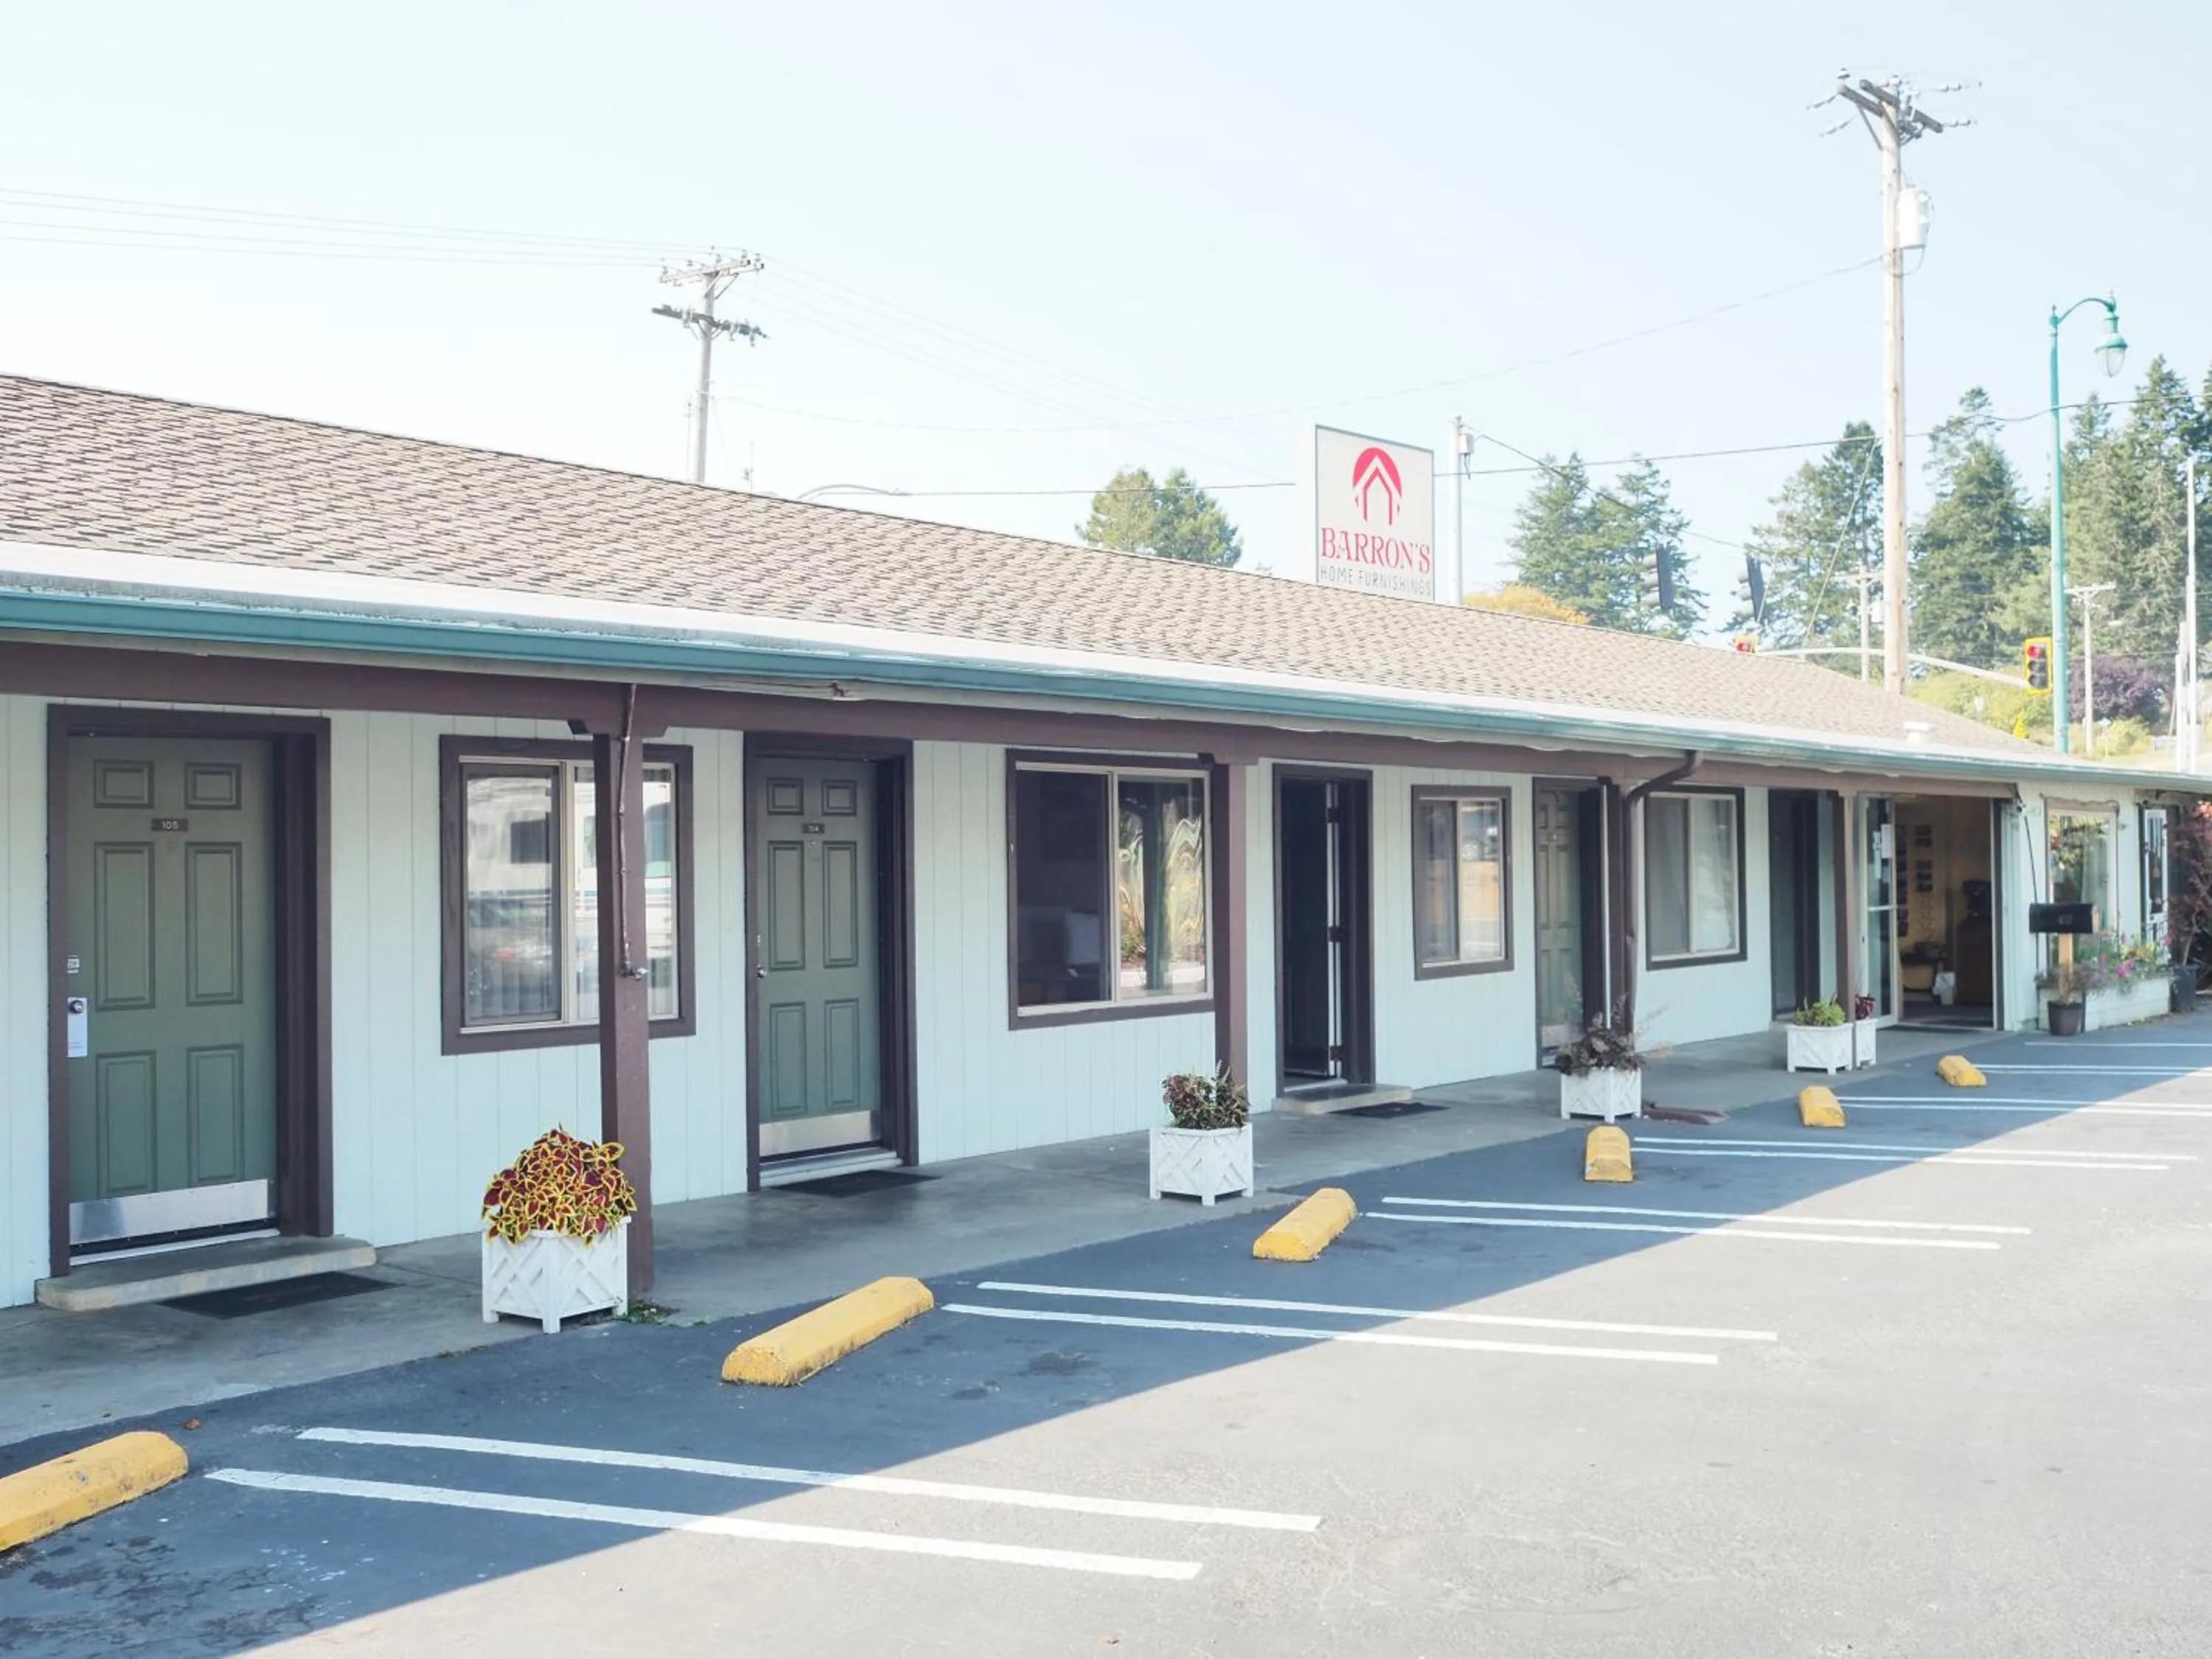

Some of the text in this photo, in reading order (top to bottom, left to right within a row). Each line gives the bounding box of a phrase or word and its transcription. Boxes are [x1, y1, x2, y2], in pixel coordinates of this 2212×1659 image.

[1321, 527, 1430, 574] BARRON'S
[1321, 566, 1431, 596] HOME FURNISHINGS
